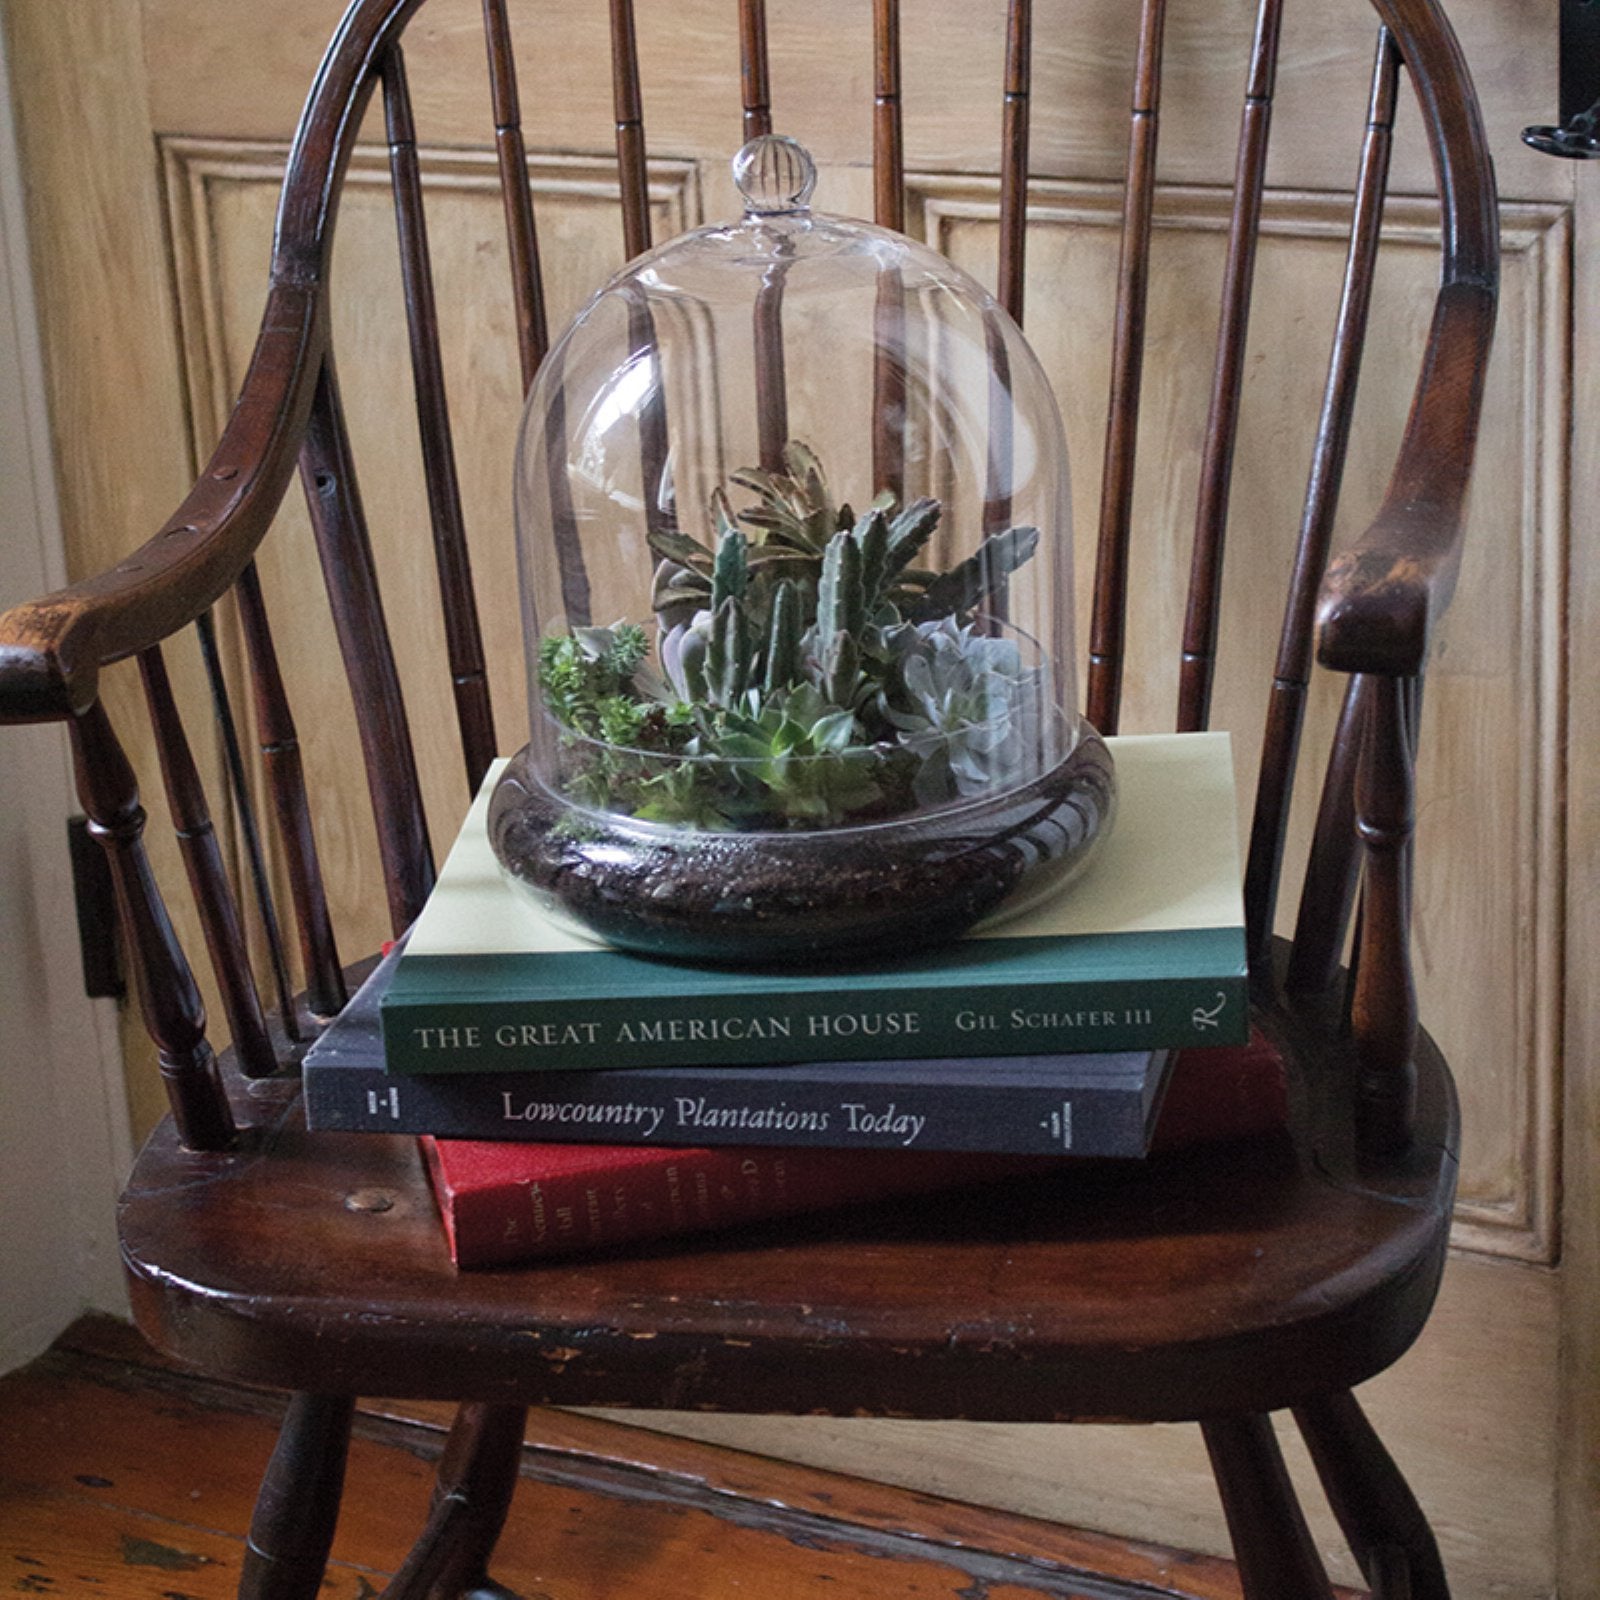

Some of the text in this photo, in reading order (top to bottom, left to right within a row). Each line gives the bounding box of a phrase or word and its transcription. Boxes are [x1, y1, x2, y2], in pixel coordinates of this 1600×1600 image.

[414, 1012, 920, 1049] THE GREAT AMERICAN HOUSE
[1010, 1008, 1116, 1029] SCHAFER
[502, 1092, 927, 1145] Lowcountry Plantations Today
